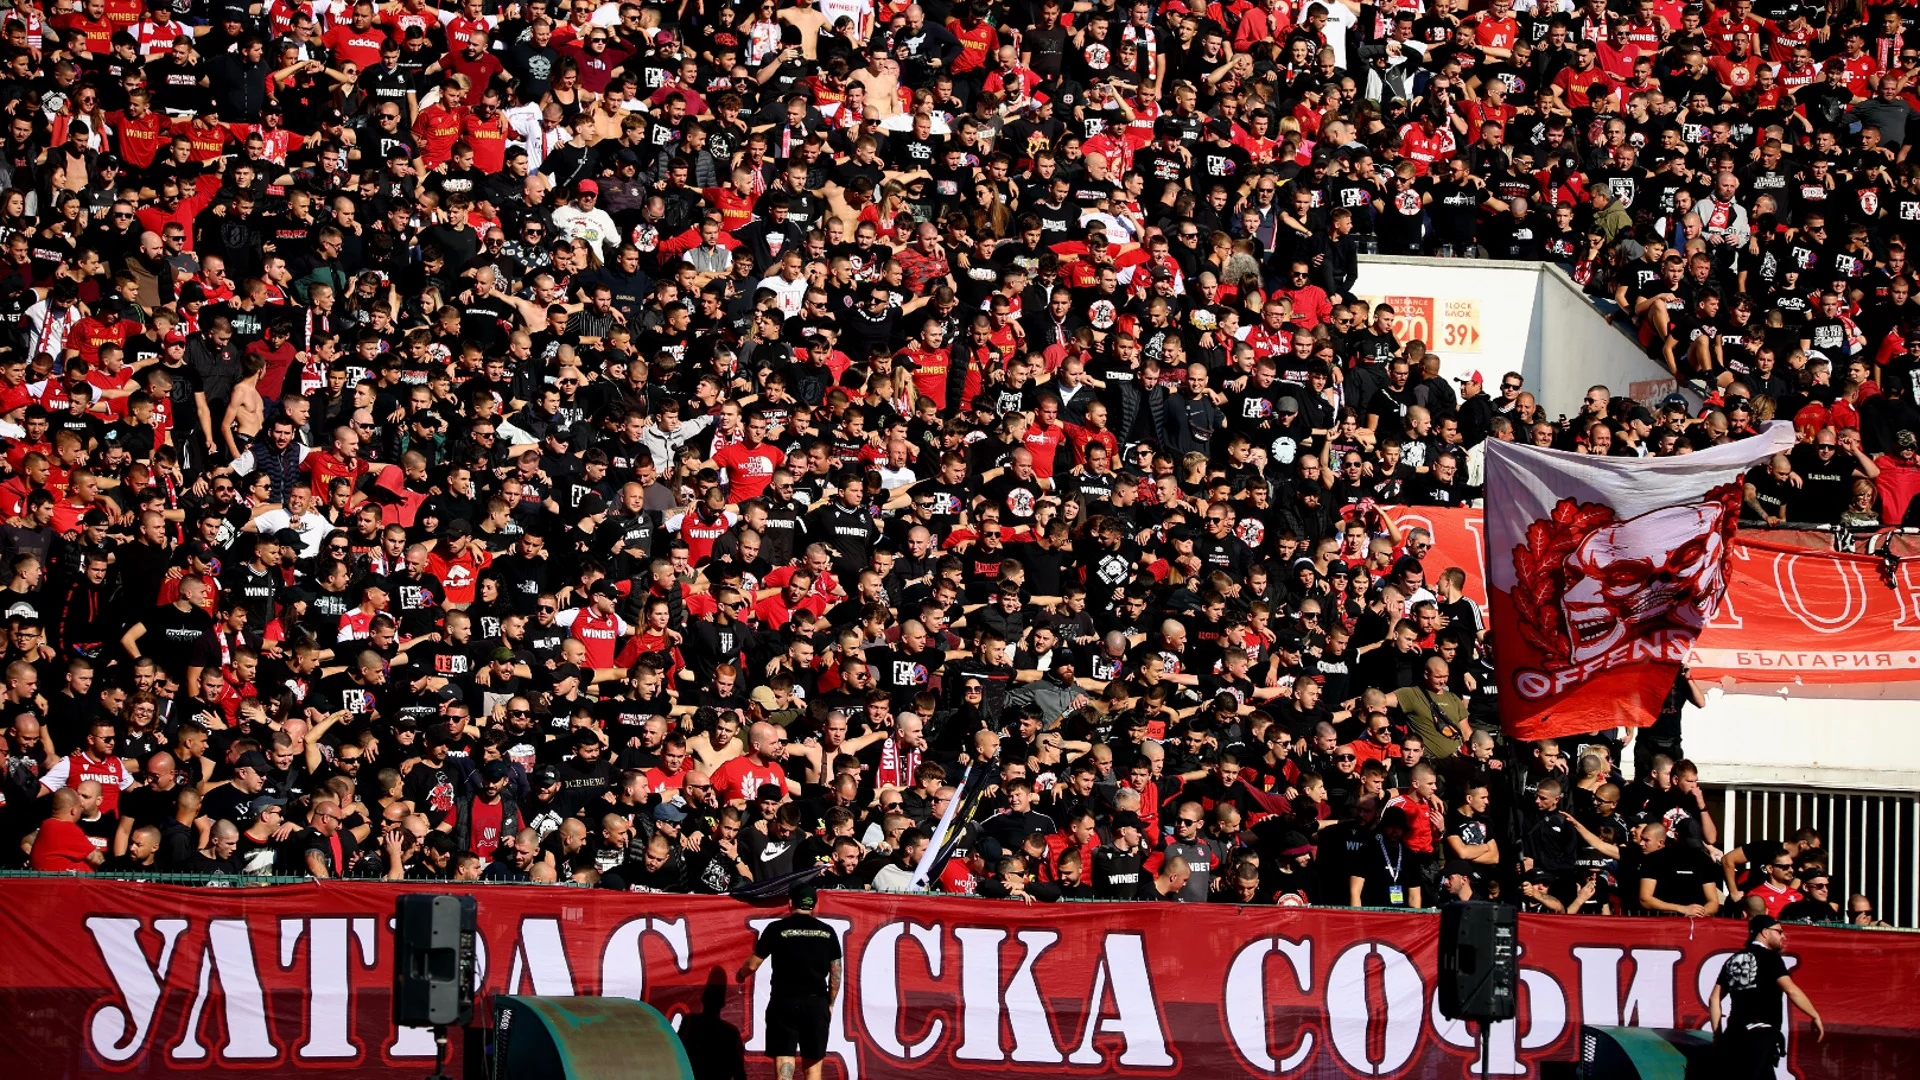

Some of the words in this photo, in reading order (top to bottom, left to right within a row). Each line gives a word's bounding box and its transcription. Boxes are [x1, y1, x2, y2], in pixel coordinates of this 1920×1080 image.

[828, 3, 859, 12] WINBET
[107, 13, 139, 21] WINBET
[335, 16, 353, 25] WIN
[1491, 34, 1506, 46] A1
[1629, 33, 1658, 42] WINBET
[151, 39, 173, 48] WINB
[645, 67, 664, 77] FCK
[1497, 73, 1516, 84] FCK
[1784, 76, 1813, 85] WINBET
[376, 89, 406, 97] WINBET
[1569, 84, 1587, 93] WIN
[653, 124, 671, 135] FCK
[1682, 122, 1701, 133] FCK
[192, 141, 223, 151] WINBET
[1207, 155, 1226, 166] FCK
[1341, 187, 1360, 198] FCK
[1901, 201, 1920, 211] FCK
[723, 209, 752, 219] WINBET
[1792, 246, 1811, 259] FCK
[1836, 254, 1855, 267] FCK
[1392, 315, 1428, 347] 20
[1444, 324, 1467, 345] 39
[347, 367, 366, 378] FCK
[50, 399, 70, 409] WIN
[1243, 397, 1263, 408] FCK
[1080, 486, 1112, 496] WINBET
[766, 519, 794, 528] WINBET
[690, 529, 725, 539] WINBET
[834, 526, 868, 537] WINBET
[400, 586, 421, 597] FCK
[582, 628, 615, 639] WINBET
[1736, 652, 1892, 667] БЪЛГАРИЯ
[893, 661, 915, 673] FCK
[893, 672, 917, 685] LSFC
[343, 690, 365, 702] FCK
[80, 773, 119, 784] WINBET
[565, 777, 605, 789] ICEBERG
[1188, 862, 1210, 873] NBET
[1108, 874, 1139, 885] WINBET
[85, 915, 690, 1061] УЛТАС
[1225, 937, 1797, 1080] СОФИ
